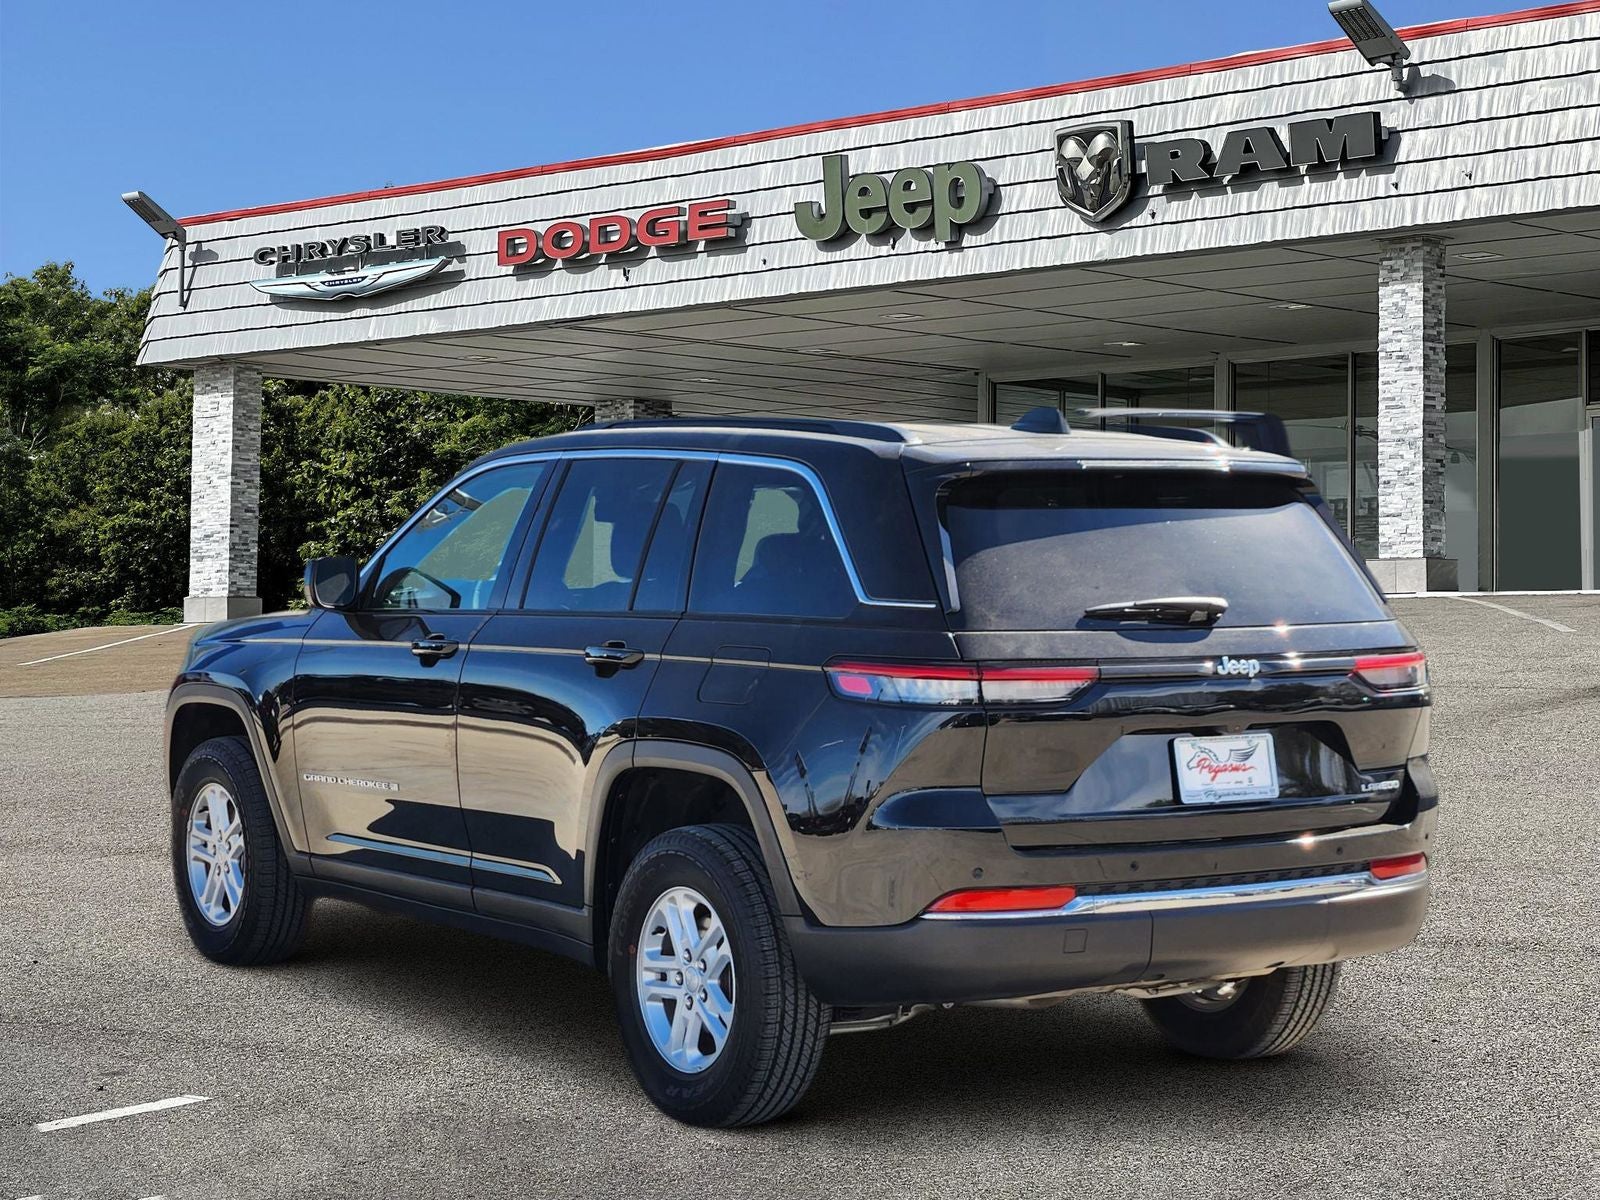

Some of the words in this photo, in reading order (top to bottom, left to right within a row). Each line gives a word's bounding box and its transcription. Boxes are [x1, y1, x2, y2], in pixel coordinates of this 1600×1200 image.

[1146, 111, 1378, 186] RAM
[795, 154, 986, 242] Jeep
[252, 225, 449, 266] CHRYSLER
[497, 199, 738, 266] DODGE
[324, 277, 363, 287] CHRYSLER
[1216, 655, 1260, 678] Jeep
[303, 773, 336, 784] GRAND
[338, 777, 389, 790] CHEROKEE
[1196, 757, 1255, 782] Pegasus
